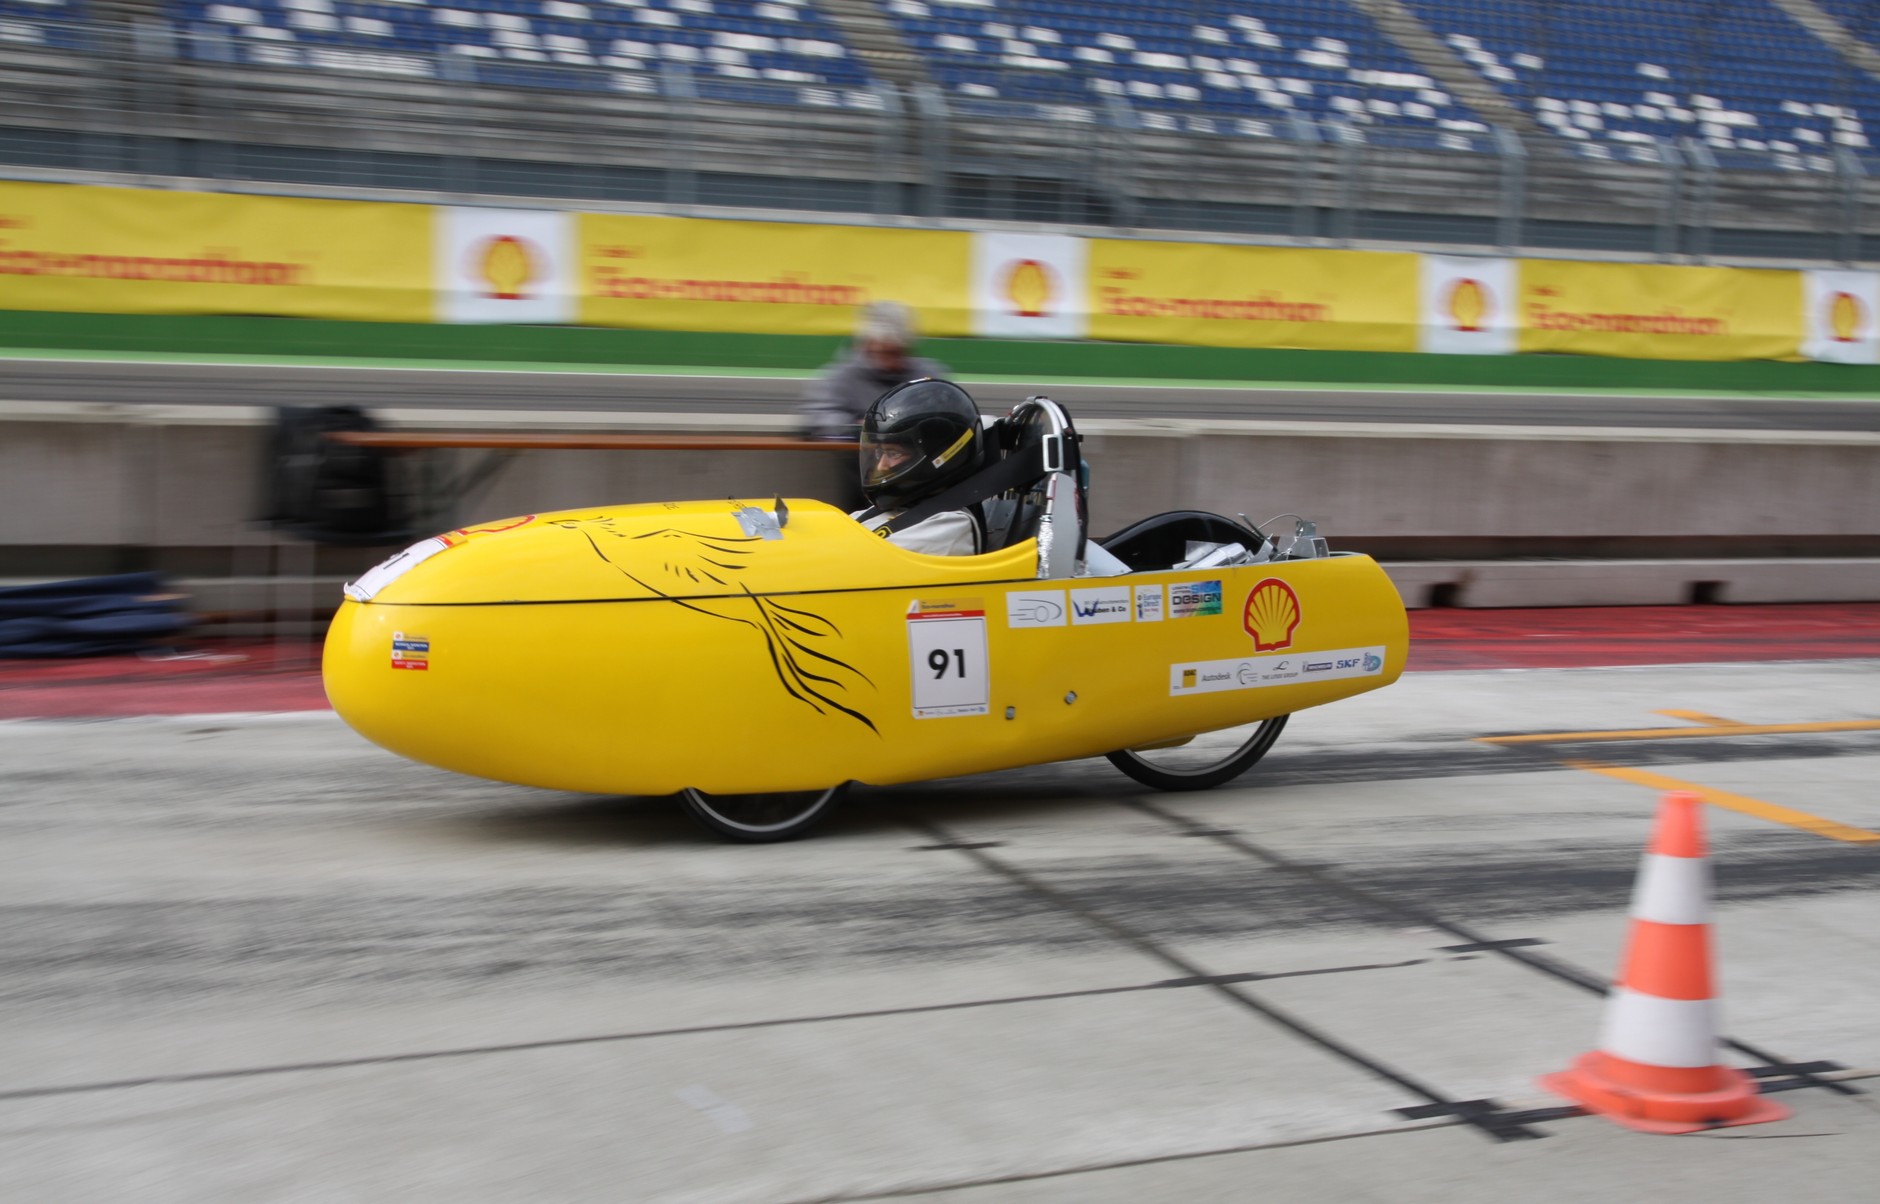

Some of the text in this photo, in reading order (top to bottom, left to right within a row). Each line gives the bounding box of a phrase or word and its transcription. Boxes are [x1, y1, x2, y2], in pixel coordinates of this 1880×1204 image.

[928, 648, 966, 680] 91
[1336, 659, 1360, 669] SKF
[1201, 672, 1231, 681] Autodesk
